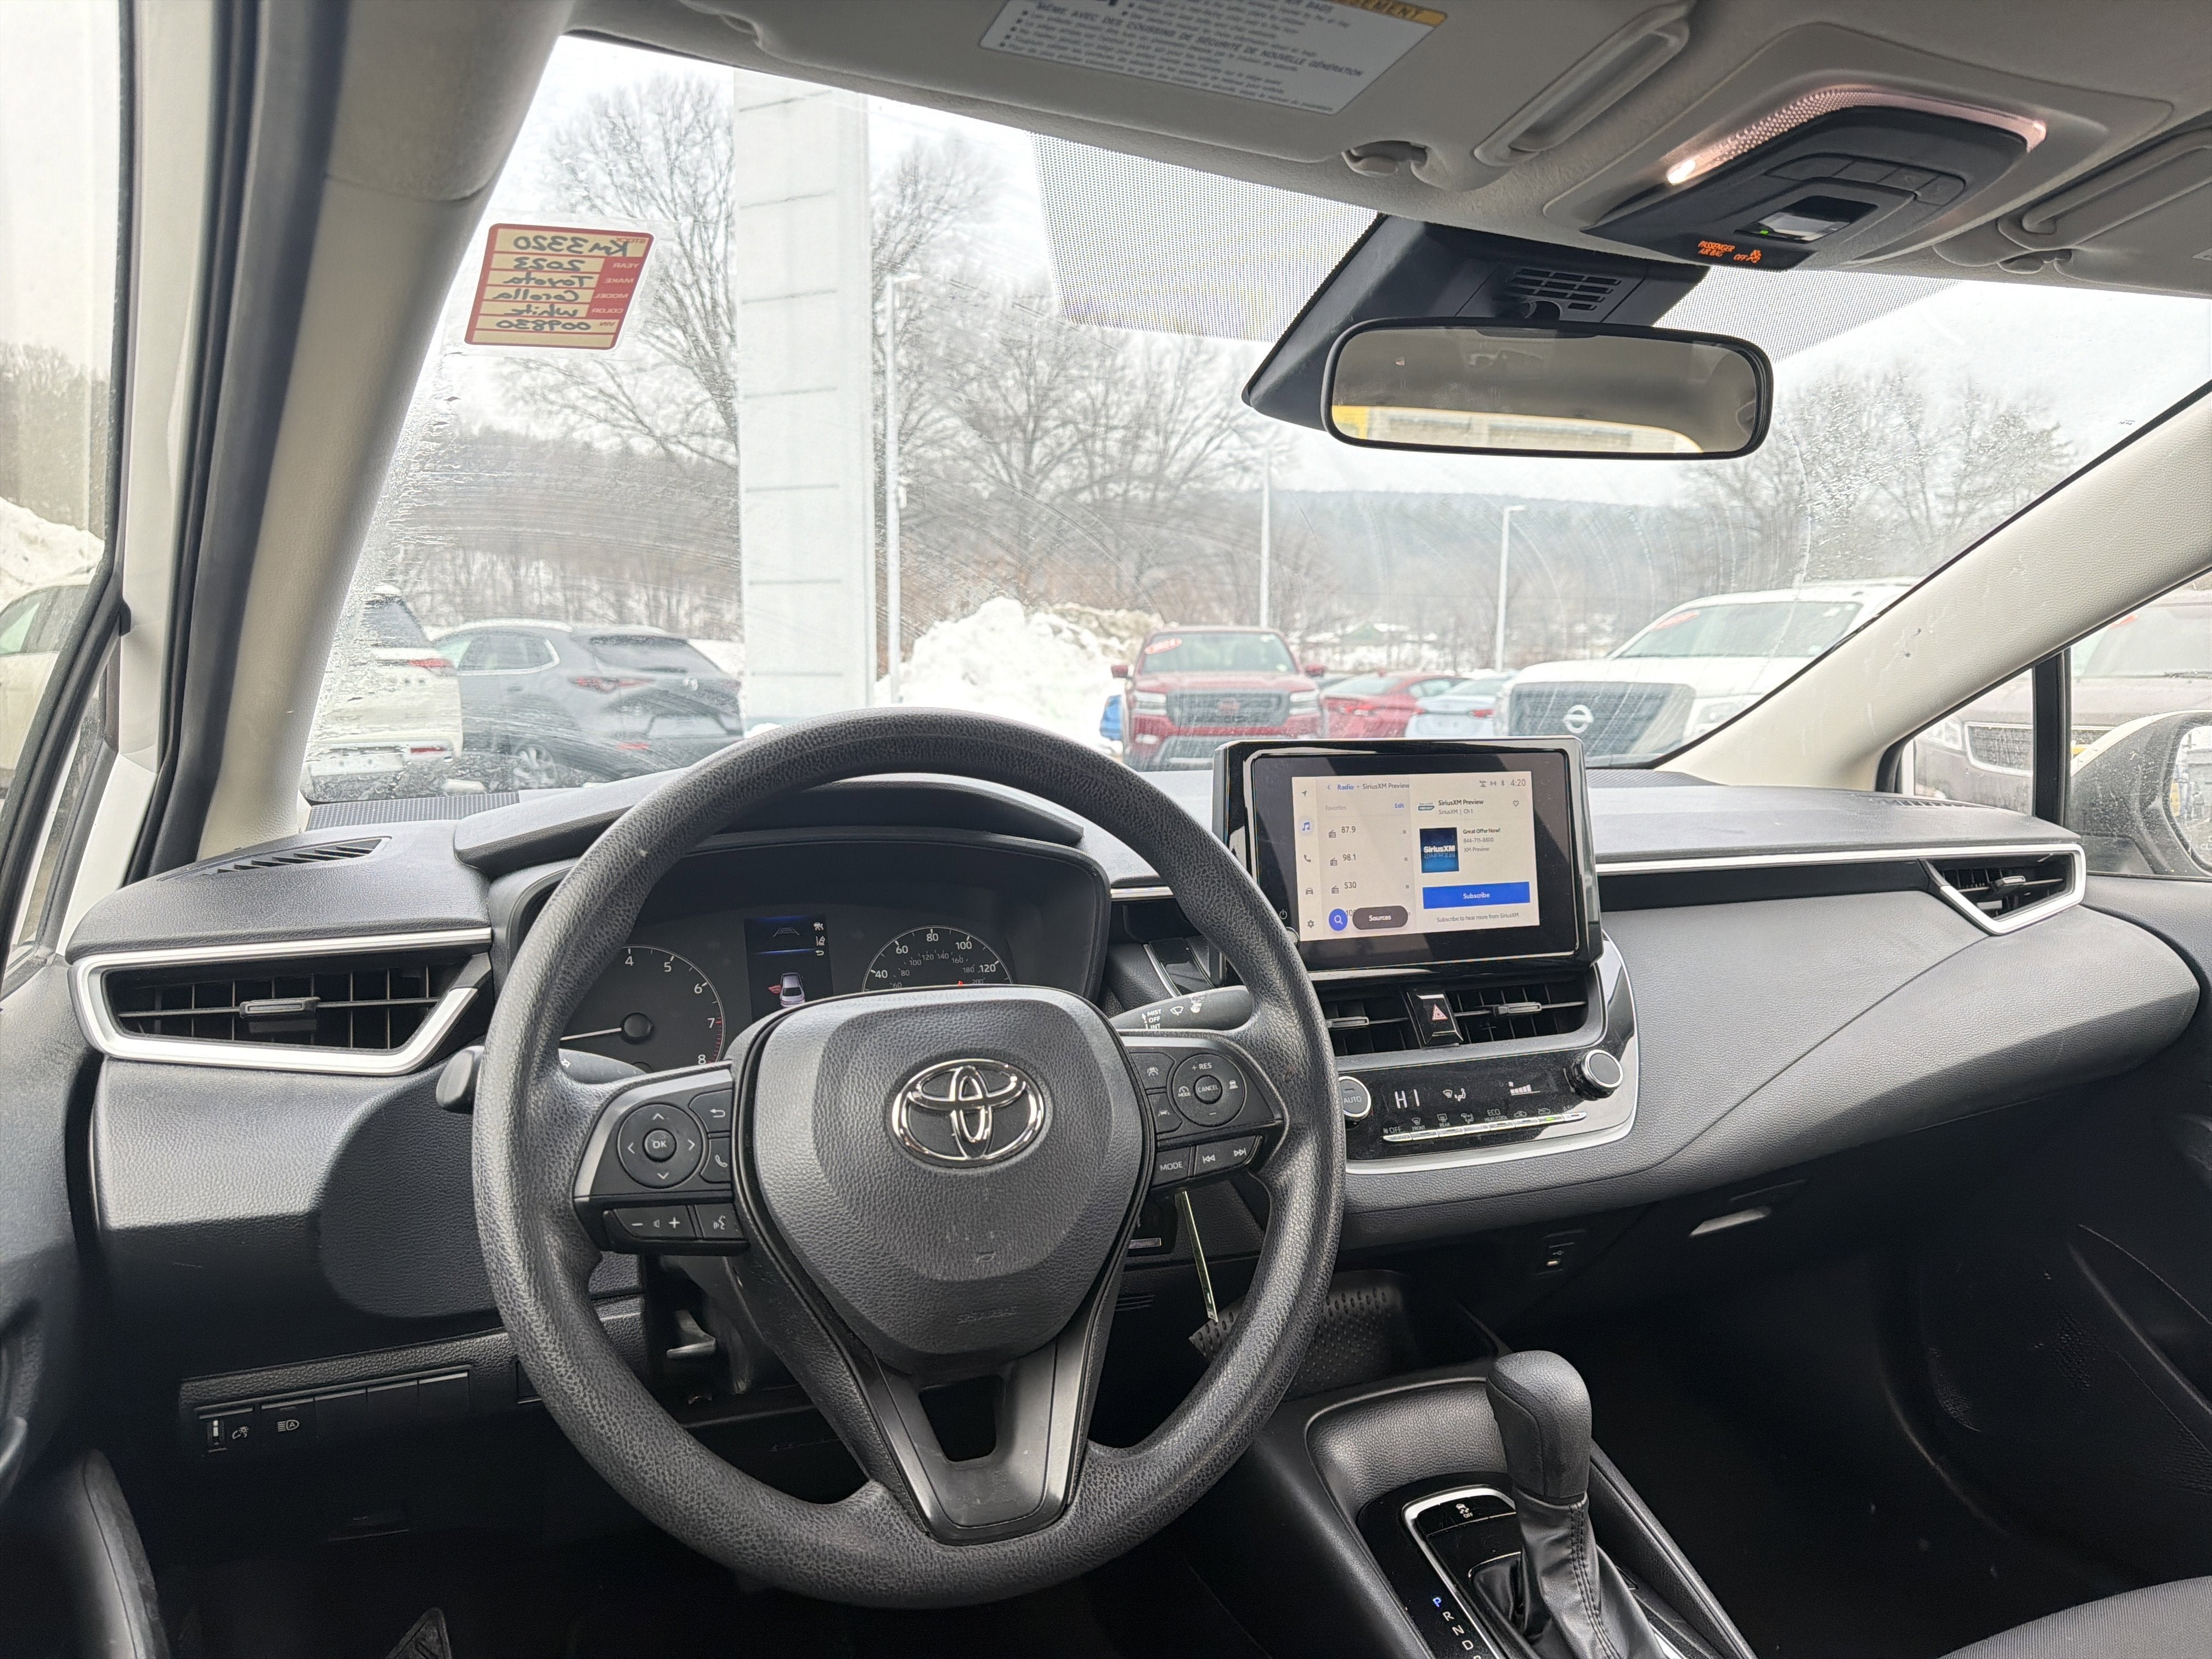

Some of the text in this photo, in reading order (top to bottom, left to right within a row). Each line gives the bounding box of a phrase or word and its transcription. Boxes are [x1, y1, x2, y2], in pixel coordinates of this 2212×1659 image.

[1698, 240, 1735, 252] PASSENGER
[1709, 249, 1724, 257] BAG
[1510, 778, 1526, 787] 4:20
[1423, 845, 1455, 853] SiriusXM
[926, 933, 939, 942] 80
[896, 945, 909, 954] 60
[955, 941, 972, 950] 100
[625, 956, 634, 966] 4
[664, 962, 672, 972] 5
[979, 964, 996, 973] 120
[874, 969, 888, 979] 40
[694, 983, 703, 994] 6
[1147, 1008, 1162, 1017] MIST
[707, 1018, 715, 1029] 7
[698, 1054, 706, 1065] 8
[1198, 1084, 1218, 1093] CANCEL
[1487, 1108, 1501, 1116] ECO
[652, 1140, 668, 1149] OK
[1160, 1160, 1183, 1171] MODE
[1432, 1597, 1442, 1607] P
[1443, 1611, 1454, 1621] R
[1452, 1624, 1465, 1636] N
[1462, 1640, 1474, 1650] D
